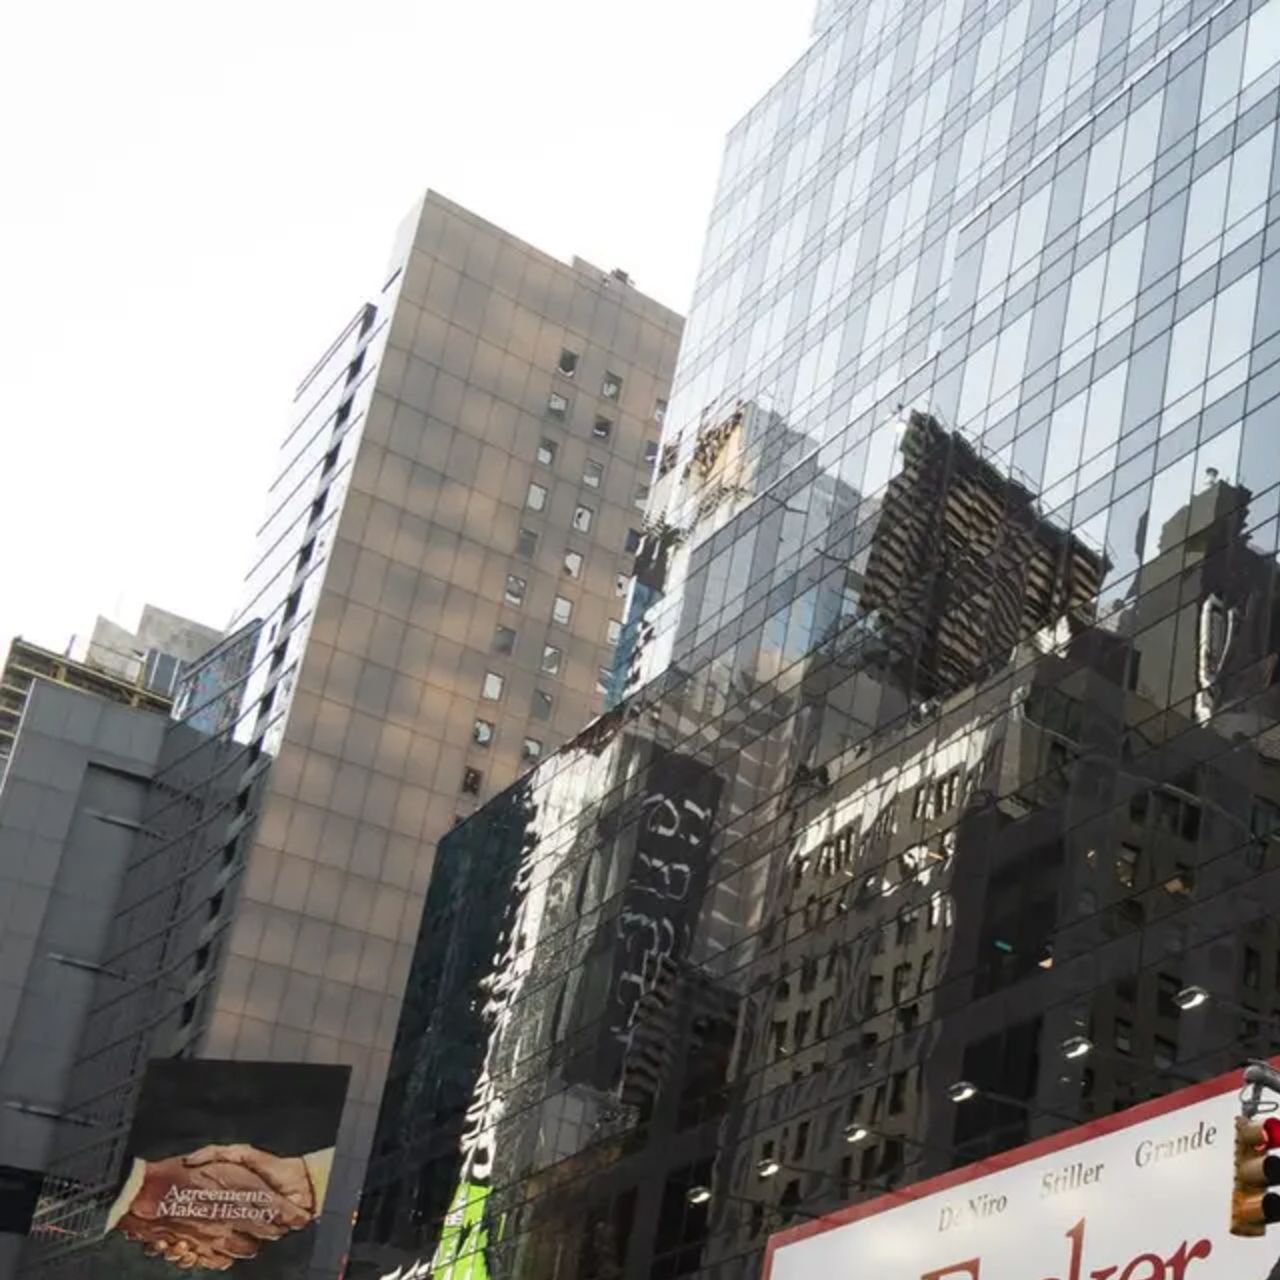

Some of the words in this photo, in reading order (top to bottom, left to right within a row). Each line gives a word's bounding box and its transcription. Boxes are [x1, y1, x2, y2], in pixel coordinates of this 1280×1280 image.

[967, 1194, 1007, 1220] Niro
[1040, 1162, 1104, 1197] Stiller
[1135, 1121, 1217, 1167] Grande
[164, 1184, 273, 1204] Agreements
[156, 1201, 208, 1217] Make
[209, 1203, 280, 1223] History
